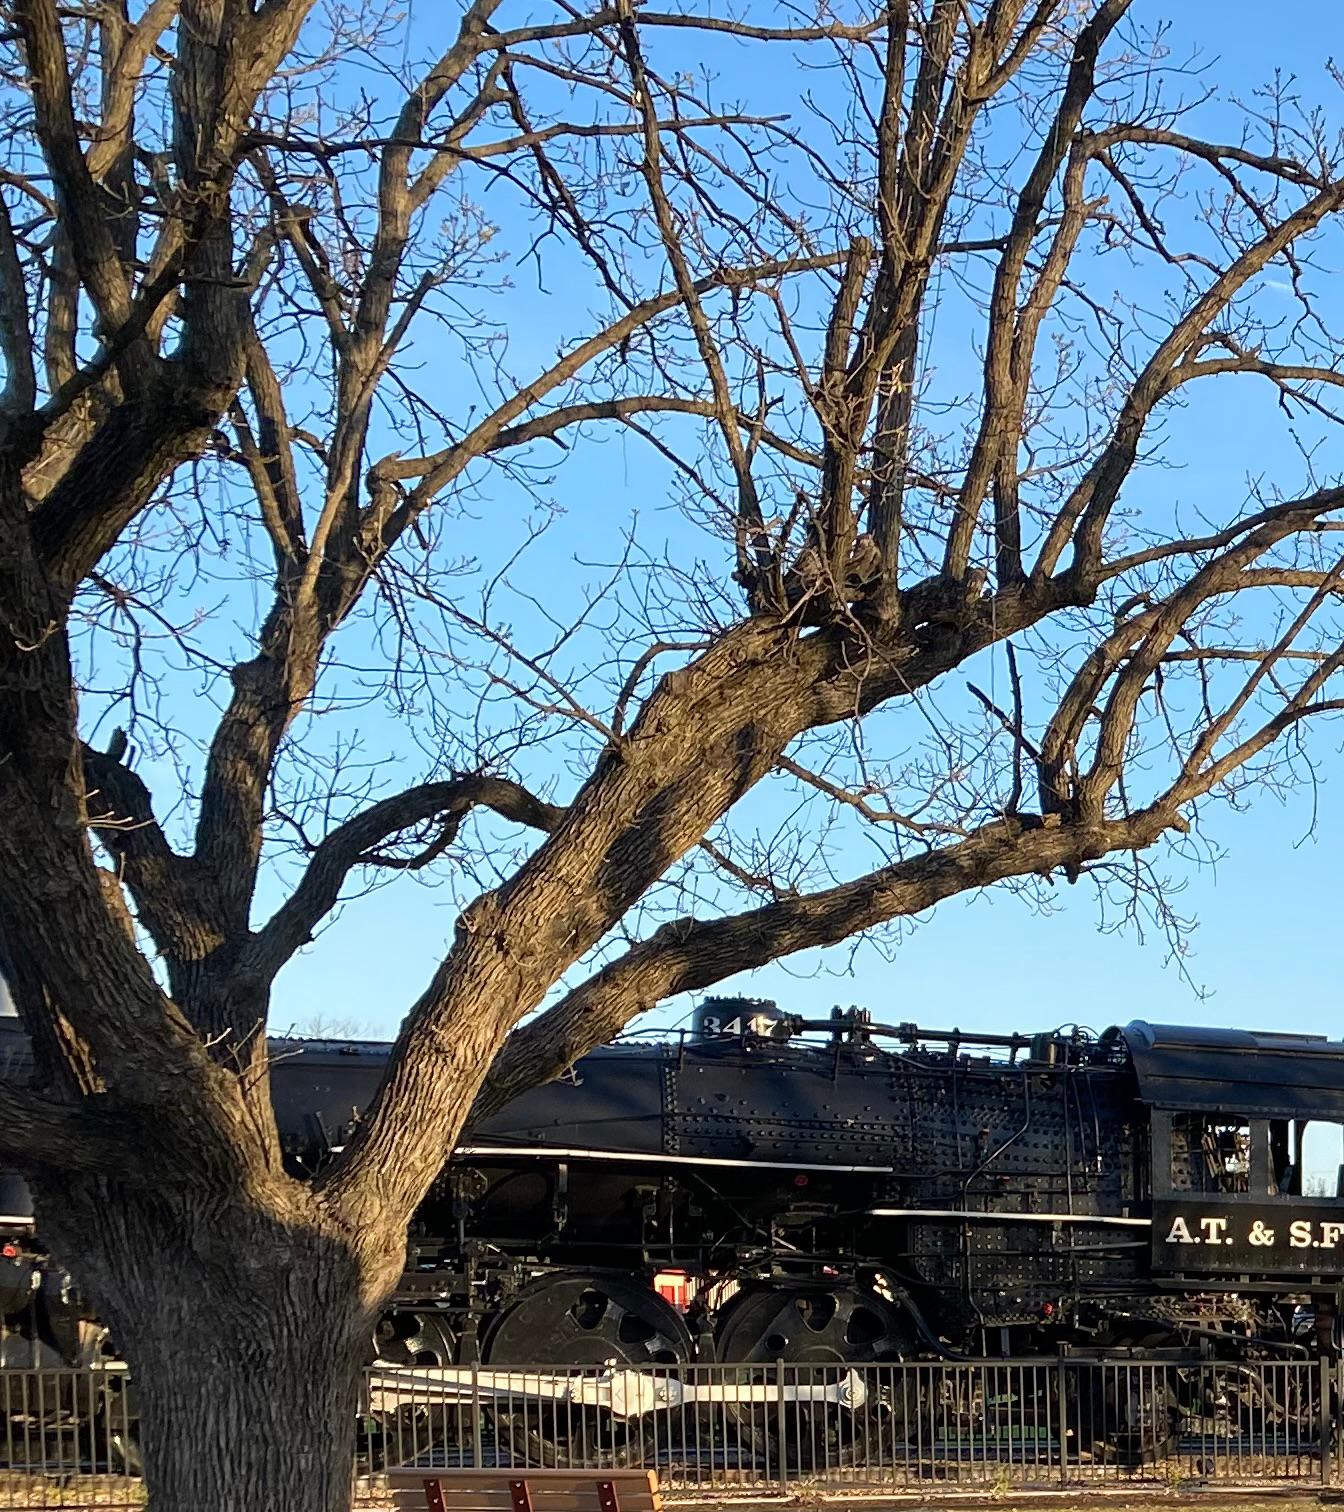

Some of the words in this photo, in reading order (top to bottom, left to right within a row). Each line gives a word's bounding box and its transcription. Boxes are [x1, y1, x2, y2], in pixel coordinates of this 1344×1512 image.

[703, 1016, 779, 1039] 3417
[1165, 1216, 1234, 1246] A.T.
[1248, 1220, 1275, 1247] &
